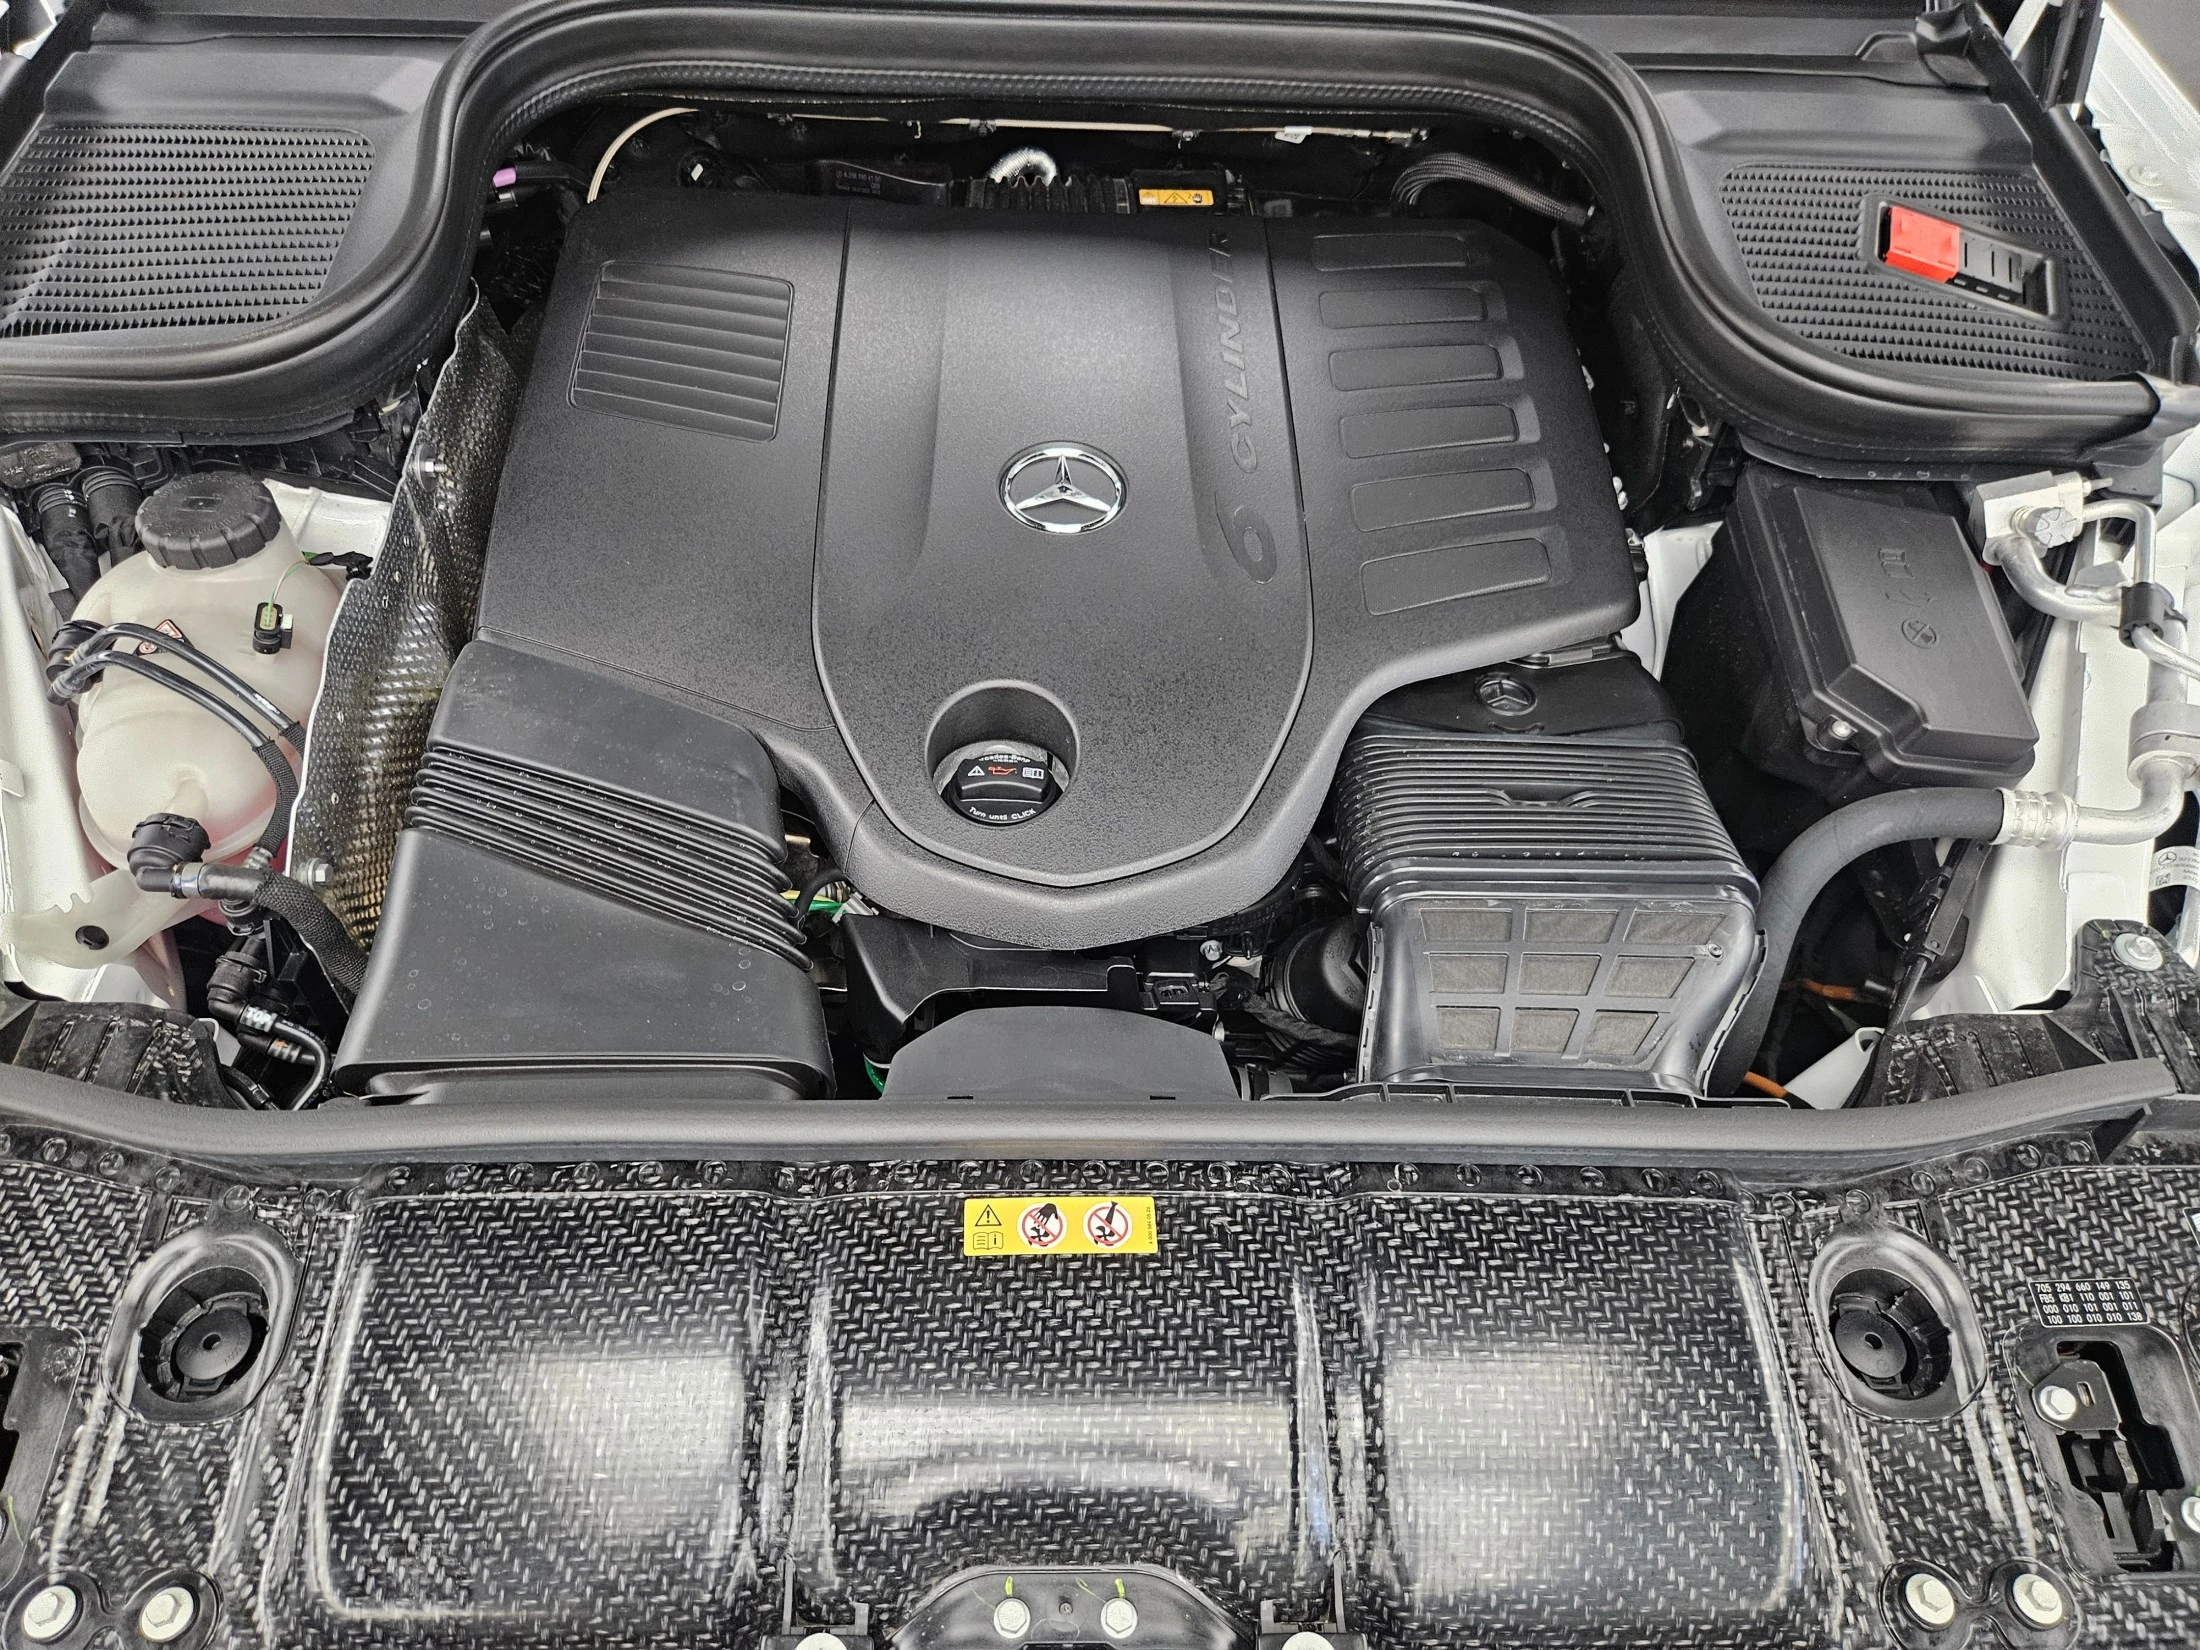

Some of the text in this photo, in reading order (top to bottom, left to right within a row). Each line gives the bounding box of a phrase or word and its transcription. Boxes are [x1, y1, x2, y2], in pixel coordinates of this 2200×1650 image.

[1208, 232, 1258, 474] CYLINDER
[969, 806, 986, 818] Turn
[1011, 808, 1036, 820] CLICK
[2035, 1280, 2131, 1293] 705 294 660 149 135
[2039, 1291, 2134, 1304] FB5 KB1 110 001 101
[2043, 1301, 2139, 1314] 000 010 101 001 011
[2047, 1311, 2143, 1324] 100 100 010 010 138
